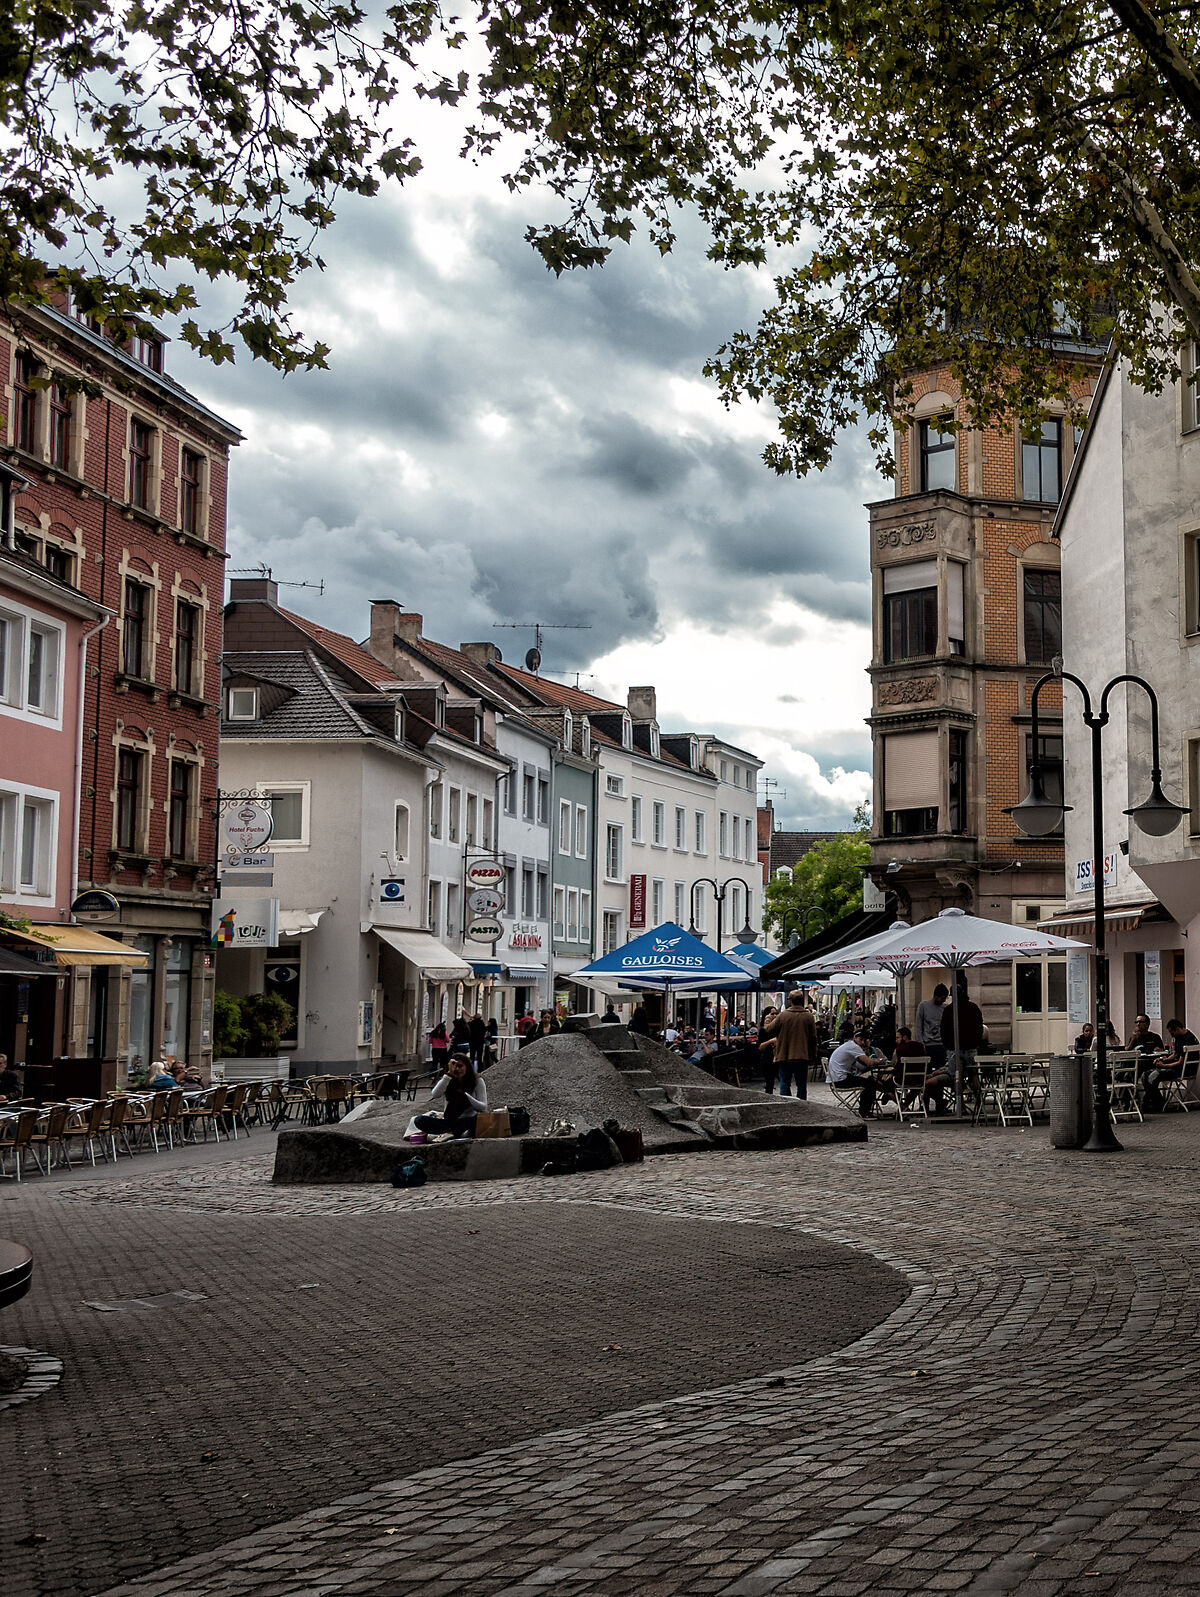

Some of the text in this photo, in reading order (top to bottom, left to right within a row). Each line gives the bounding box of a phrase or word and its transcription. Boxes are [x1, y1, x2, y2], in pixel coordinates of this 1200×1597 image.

[243, 857, 266, 865] Bar
[471, 868, 500, 877] PIZZA
[1077, 860, 1091, 879] ISS
[634, 875, 642, 911] GENERALI
[470, 926, 499, 934] PASTA
[512, 933, 527, 946] ASIA
[621, 954, 703, 966] GAULOISES
